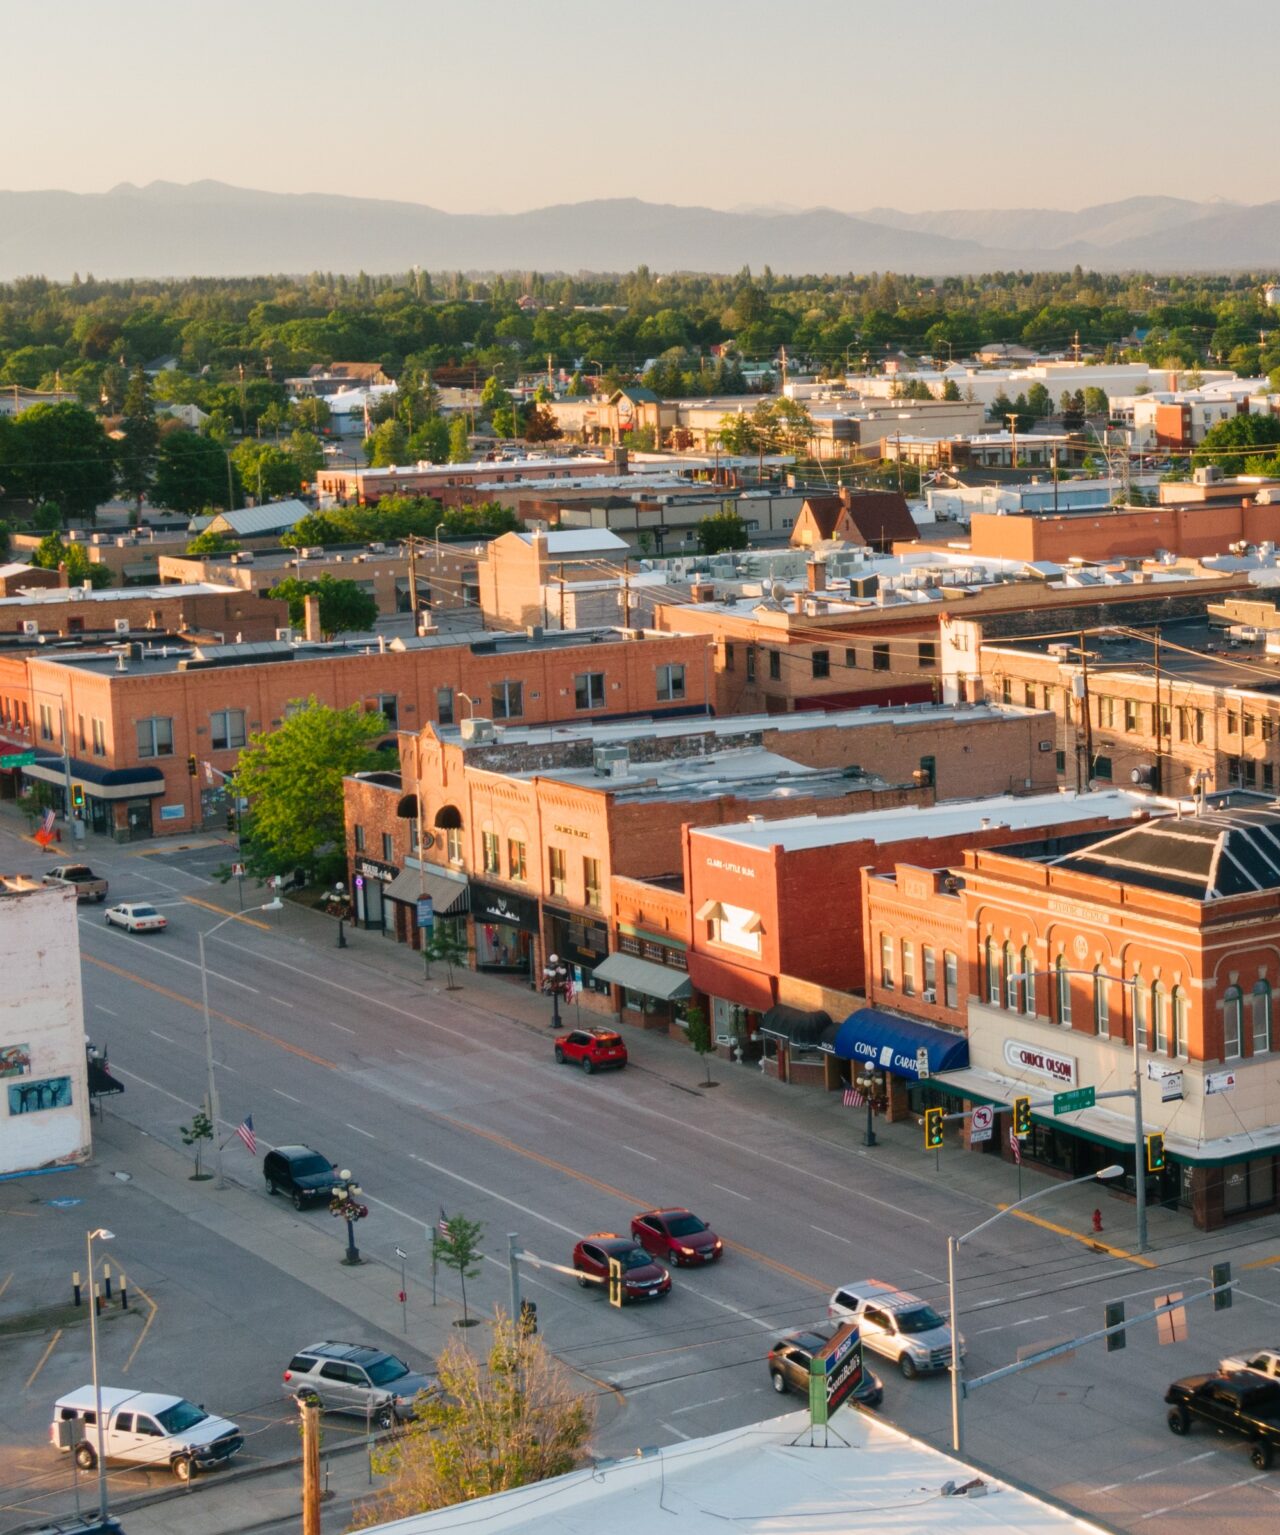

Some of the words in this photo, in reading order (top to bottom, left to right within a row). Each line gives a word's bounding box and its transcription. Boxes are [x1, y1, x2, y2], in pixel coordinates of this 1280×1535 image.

[855, 1041, 878, 1058] COINS
[1020, 1050, 1044, 1069] CHUCK
[1046, 1058, 1072, 1078] OLSON
